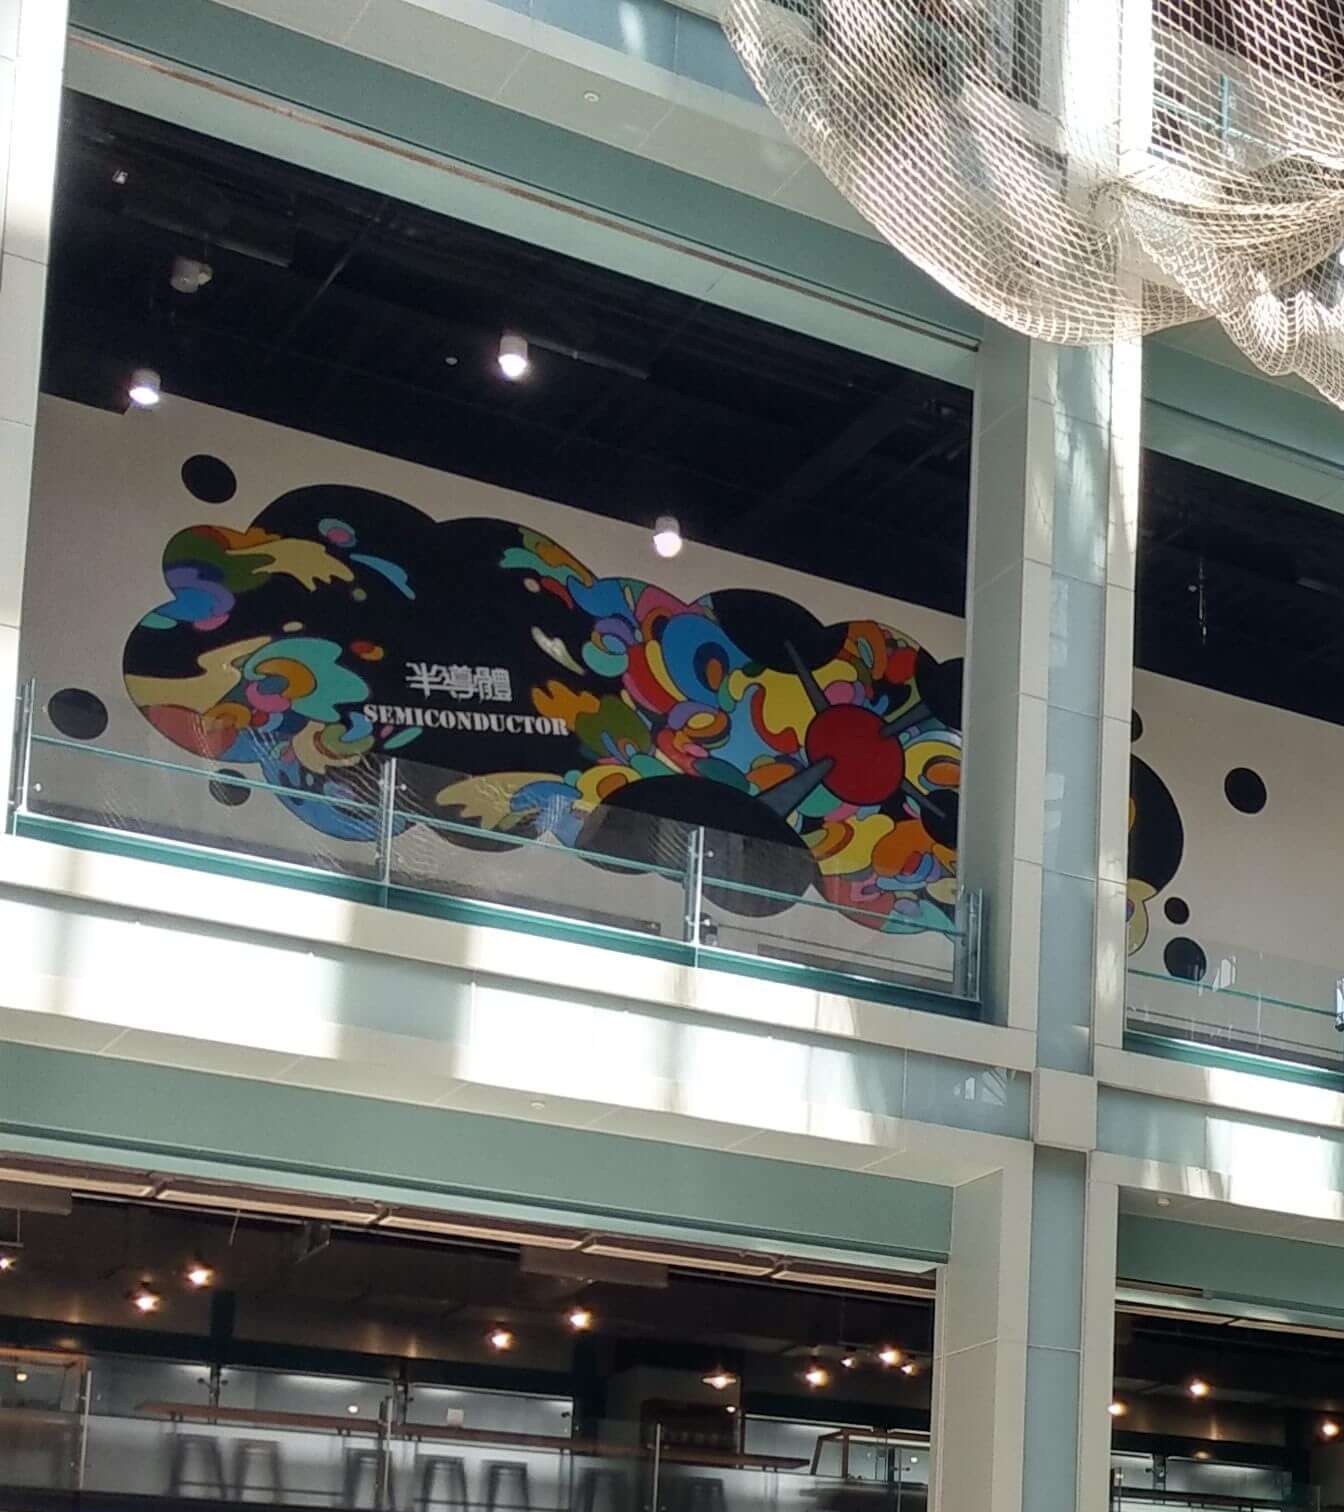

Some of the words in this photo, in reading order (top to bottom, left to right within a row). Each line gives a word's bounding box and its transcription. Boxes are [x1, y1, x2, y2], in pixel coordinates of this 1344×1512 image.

[405, 662, 512, 702] 半導體
[363, 704, 569, 736] SEMICONDUCTOR
